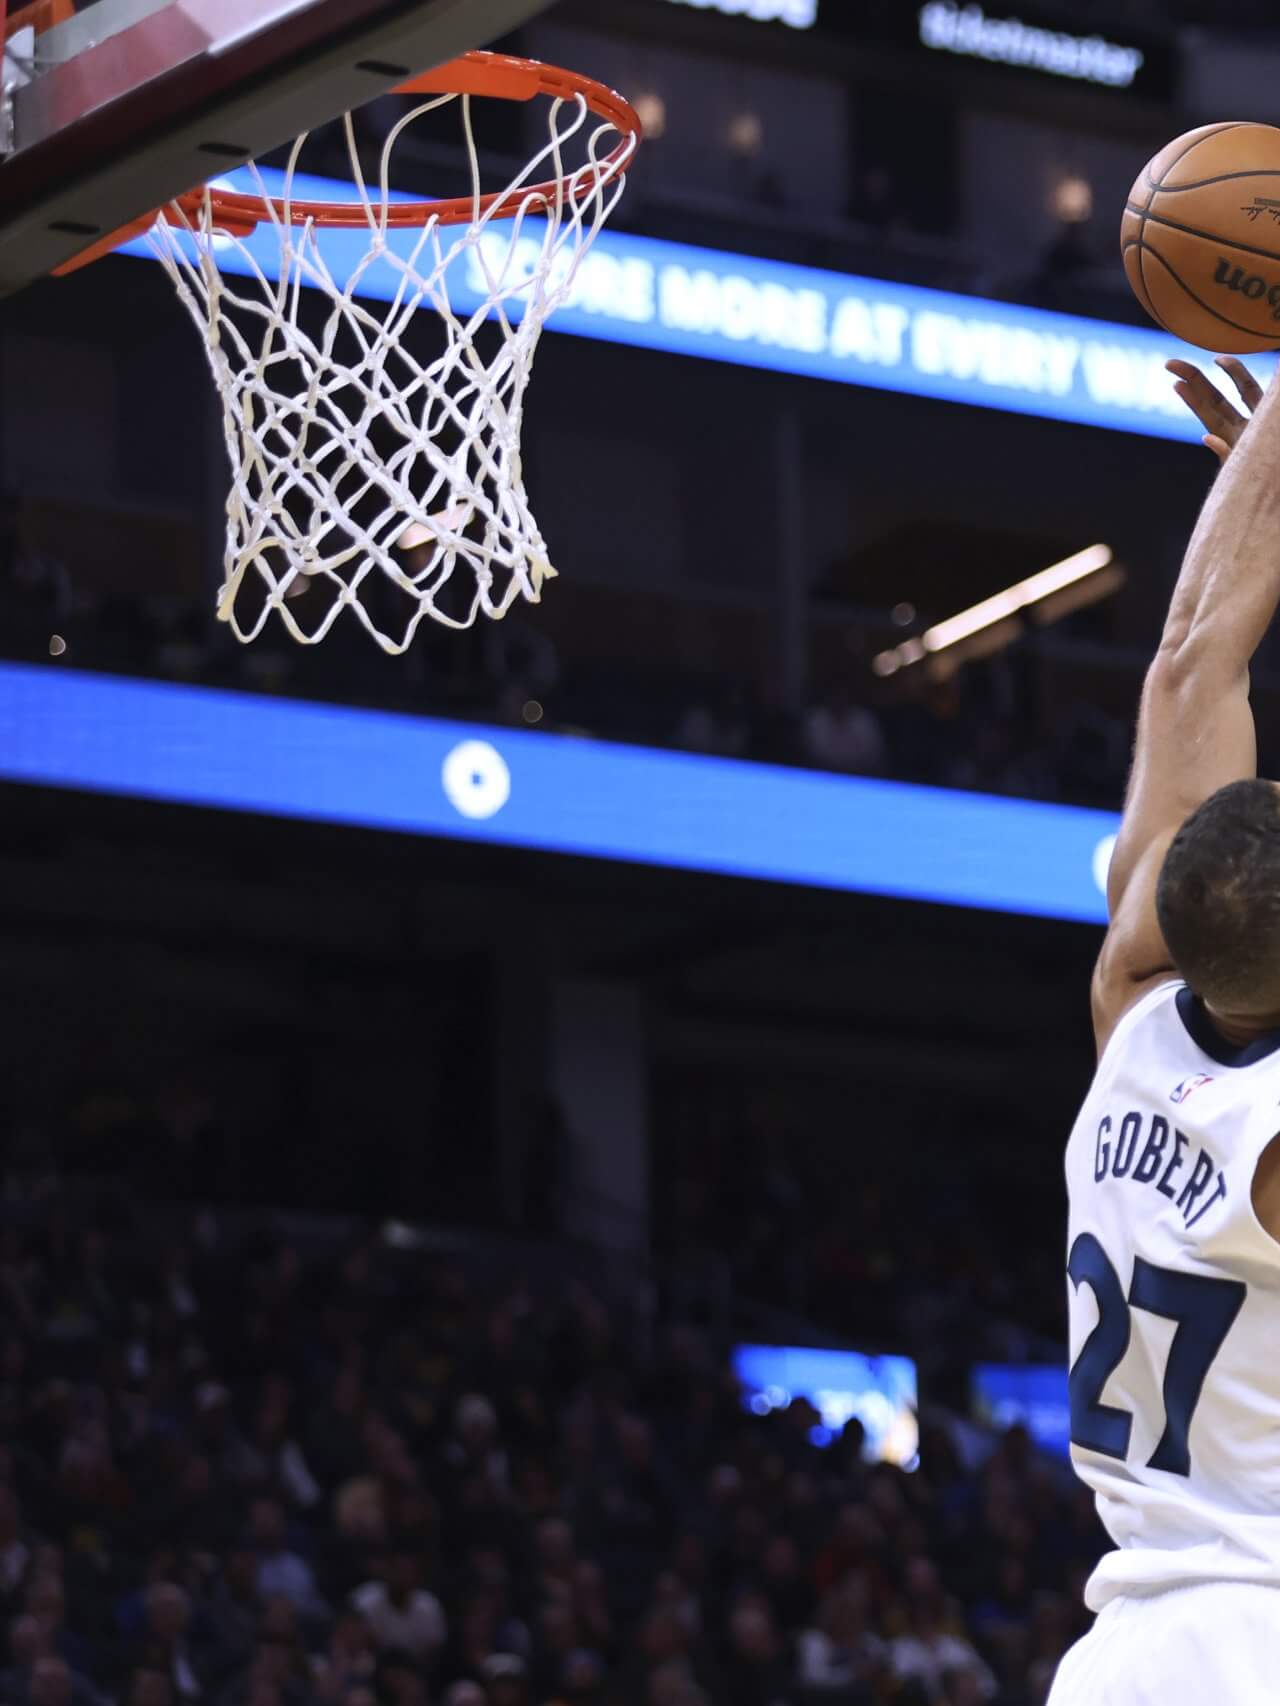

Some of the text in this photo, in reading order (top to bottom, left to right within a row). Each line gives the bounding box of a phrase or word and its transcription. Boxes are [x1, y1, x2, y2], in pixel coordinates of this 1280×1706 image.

[659, 264, 827, 353] MORE
[830, 297, 908, 367] AT
[911, 310, 1078, 396] EVERY
[1094, 1111, 1228, 1230] GOBERT
[1067, 1231, 1248, 1478] 27
